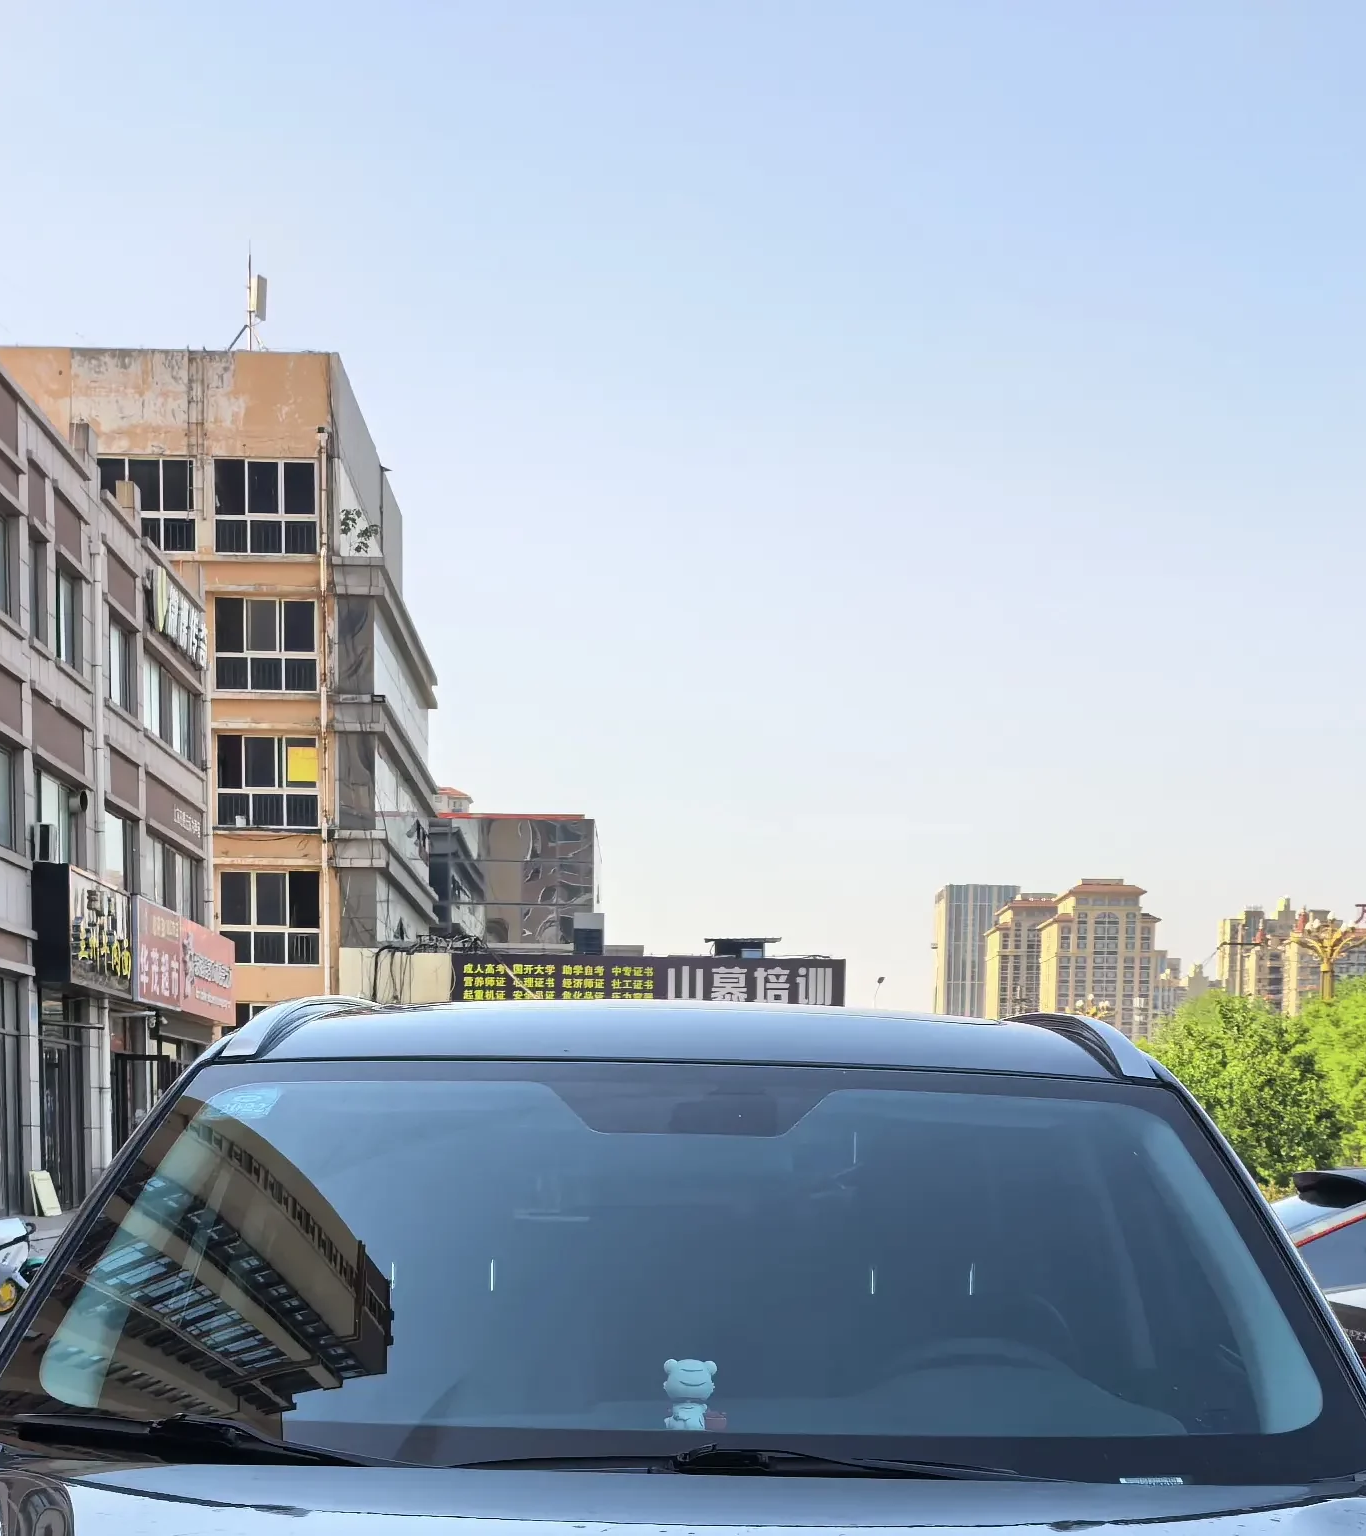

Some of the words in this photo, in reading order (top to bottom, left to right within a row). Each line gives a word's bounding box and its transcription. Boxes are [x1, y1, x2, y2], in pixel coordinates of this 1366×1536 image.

[463, 963, 506, 975] 成人高考
[513, 963, 556, 975] 国开大学
[463, 976, 506, 988] 营养师证
[611, 979, 654, 989] 社工证书
